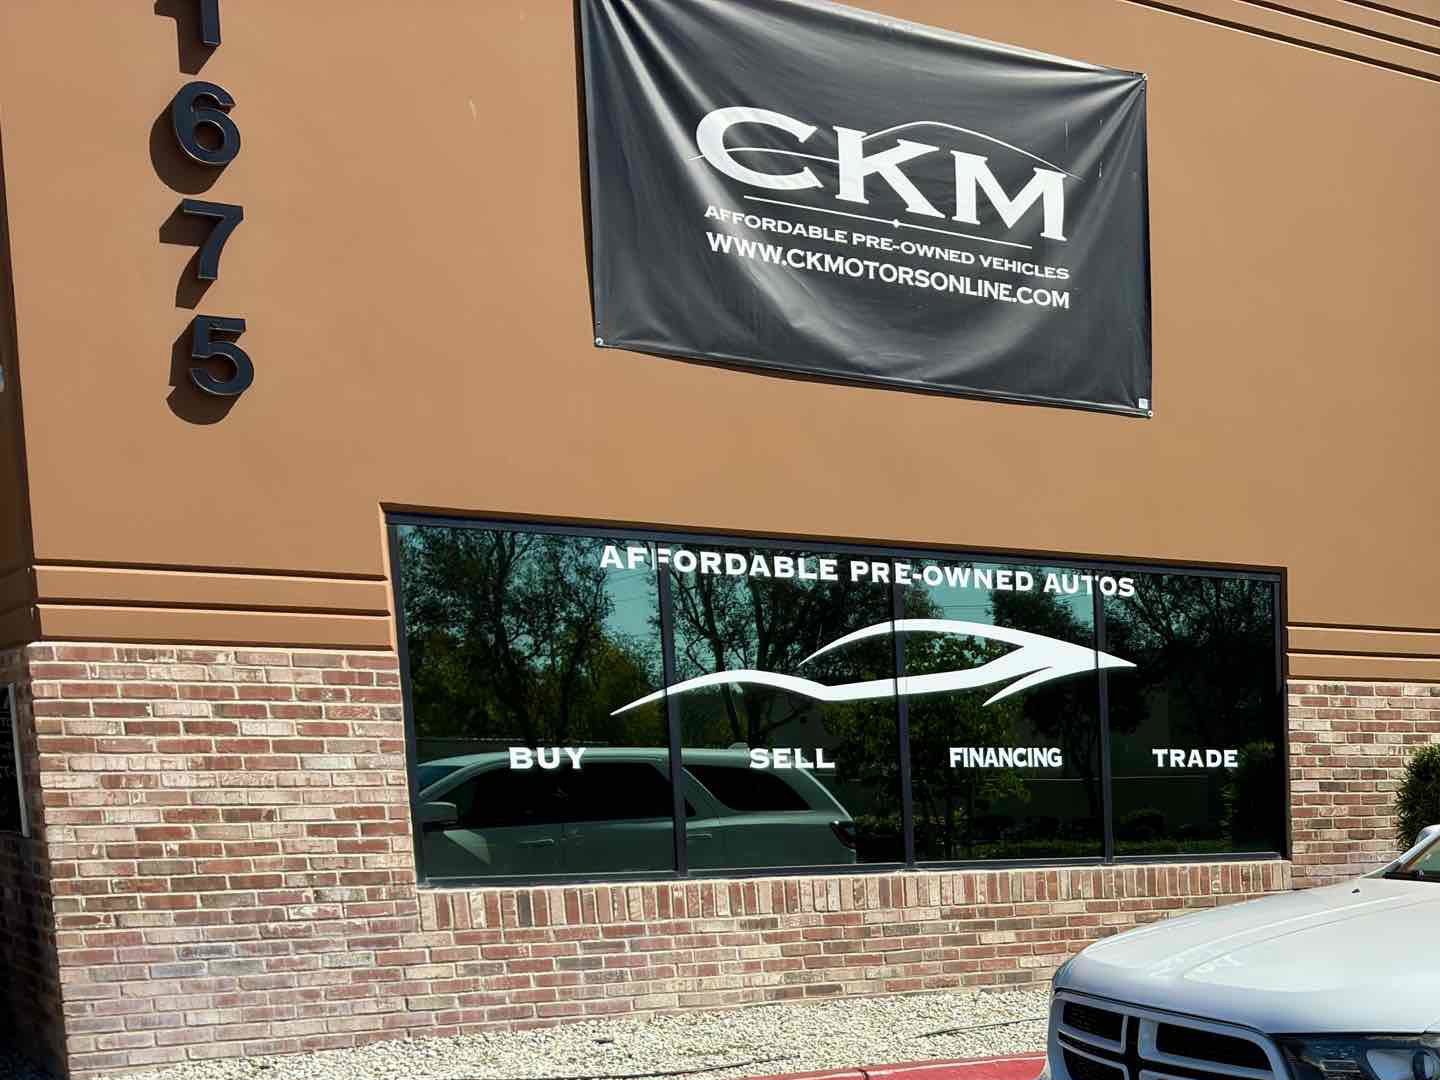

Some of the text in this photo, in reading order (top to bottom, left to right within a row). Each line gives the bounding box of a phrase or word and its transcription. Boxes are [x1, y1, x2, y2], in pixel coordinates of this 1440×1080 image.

[696, 106, 1067, 241] CKM
[704, 205, 1070, 280] AFFORDABLE PRE-OWNED VEHICLES
[705, 231, 1070, 309] WWW.CKMOTORSONLINE.COM
[599, 545, 1136, 598] AFFORDABLE PRE-OWNED AUTOS
[508, 746, 1239, 770] BUY SELL FINANCING TRADE
